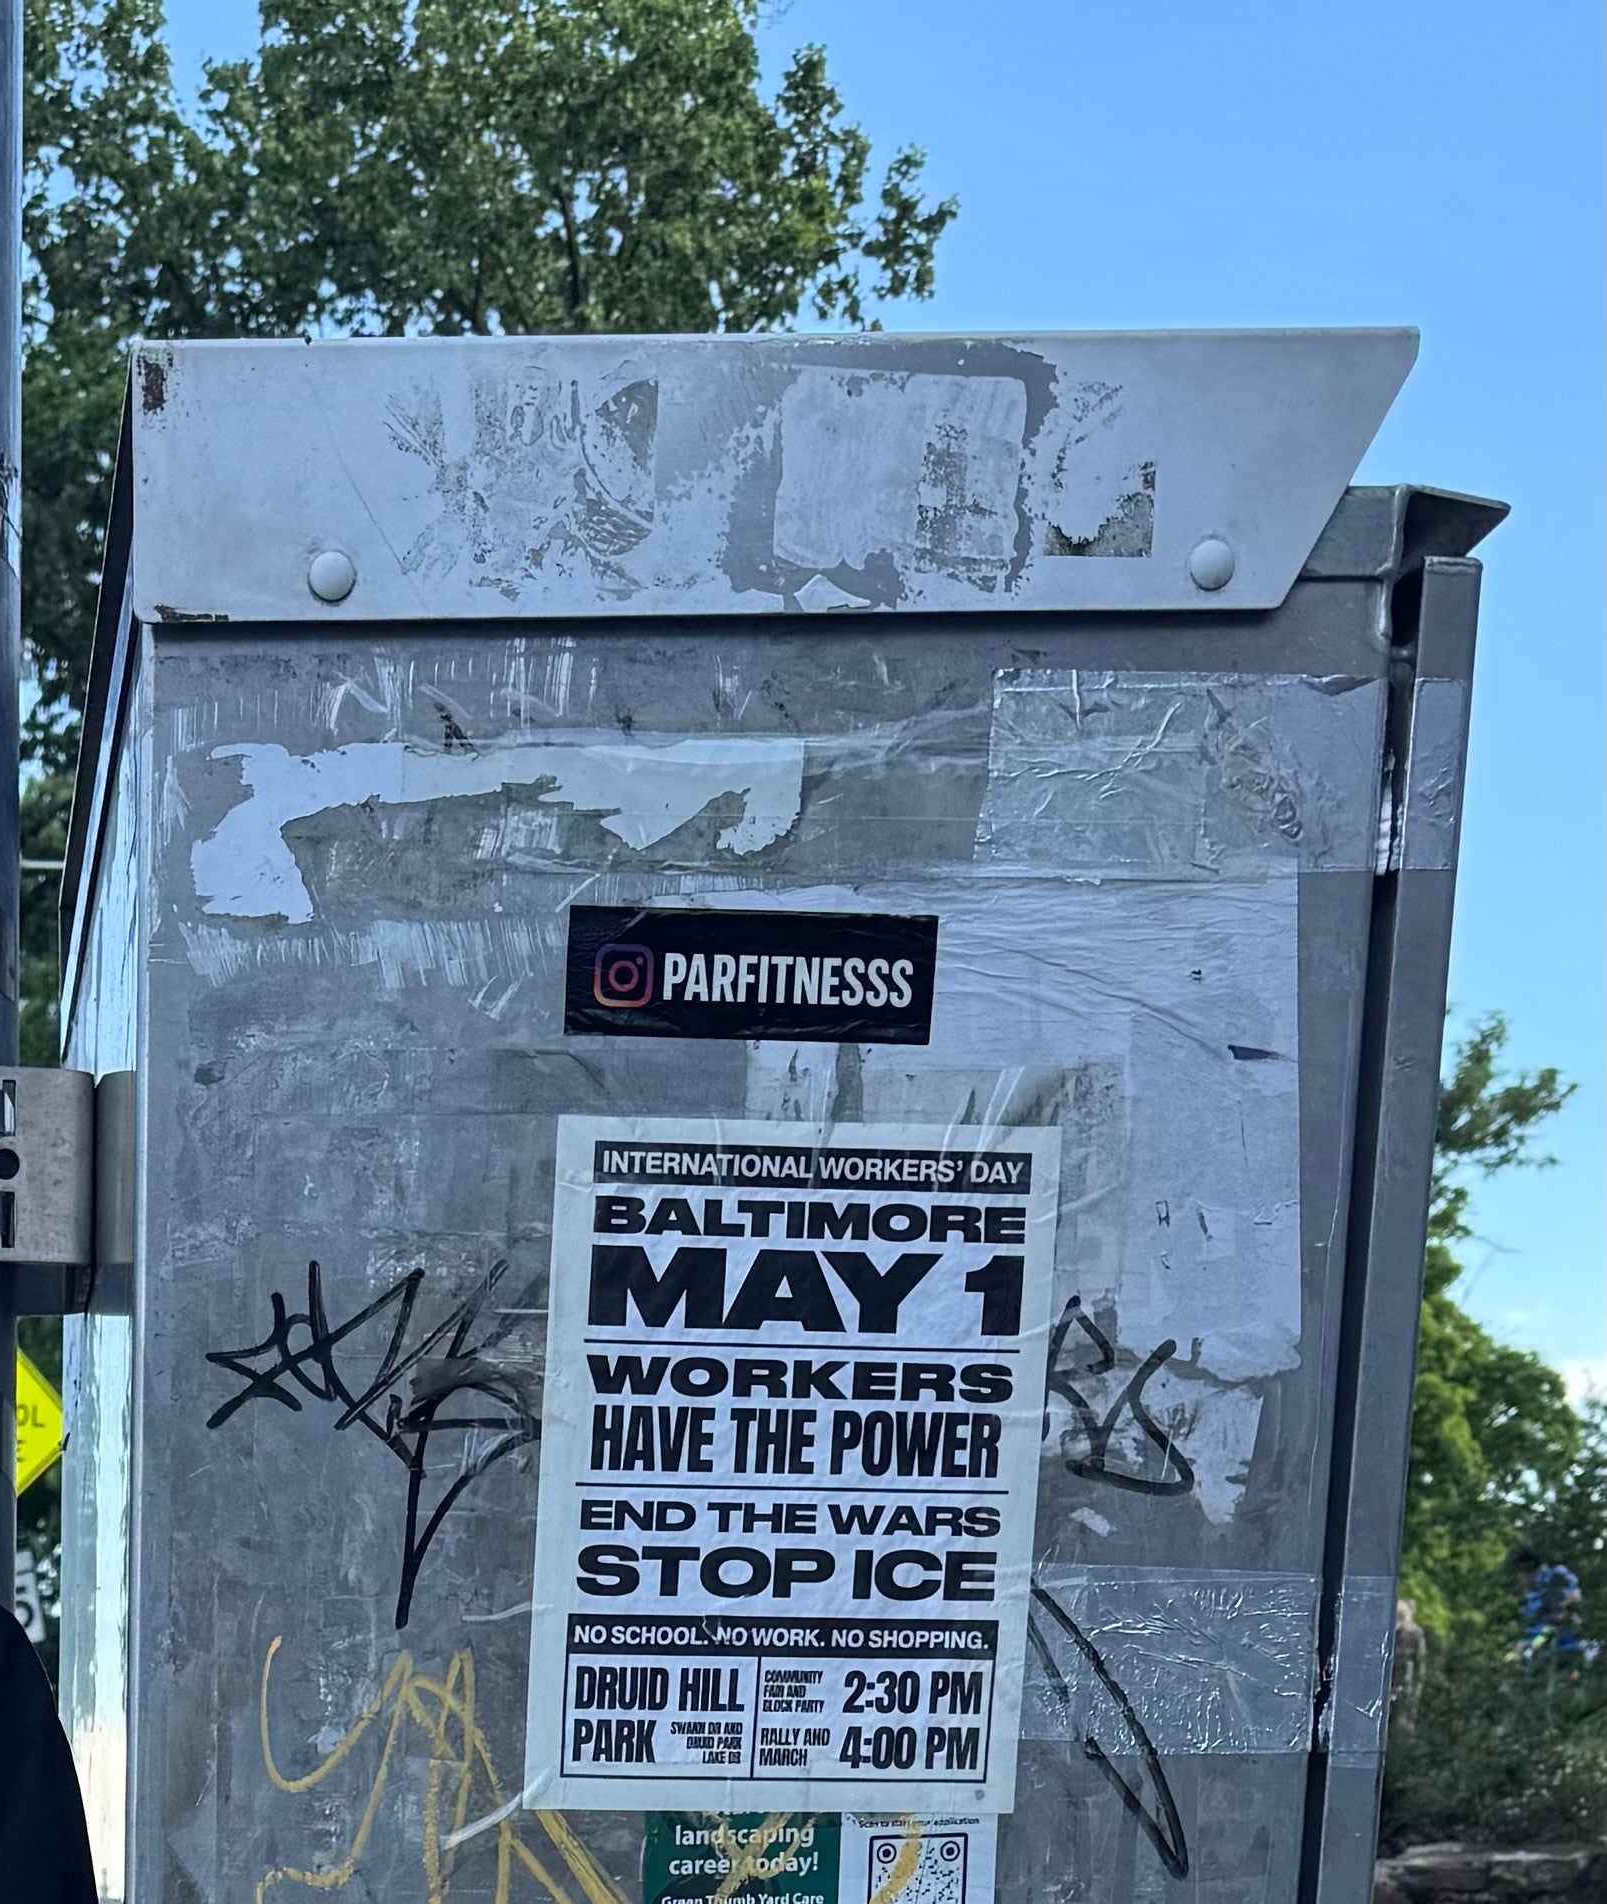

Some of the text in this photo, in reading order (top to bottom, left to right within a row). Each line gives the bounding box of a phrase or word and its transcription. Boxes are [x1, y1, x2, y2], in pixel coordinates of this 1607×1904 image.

[662, 952, 914, 1008] PARFITNESSS
[602, 1149, 813, 1180] INTERNATIONAL
[971, 1160, 1024, 1185] DAY
[593, 1195, 1027, 1244] BALTIMORE
[587, 1244, 1025, 1336] MAY 1
[586, 1354, 1014, 1404] WORKERS
[590, 1404, 1003, 1479] HAVE THE POWER
[579, 1499, 1002, 1538] END THE WARS
[575, 1543, 998, 1602] STOP ICE
[573, 1625, 990, 1650] NO SCHOOL. NO WORK. NO SHOPPING.
[573, 1665, 745, 1713] DRUID HILL
[785, 1685, 806, 1698] AND
[841, 1669, 985, 1716] 2:30 PM
[571, 1718, 658, 1765] PARK
[759, 1748, 808, 1767] MARCH
[760, 1727, 831, 1746] RALLY AND
[838, 1725, 979, 1771] 4:00 PM
